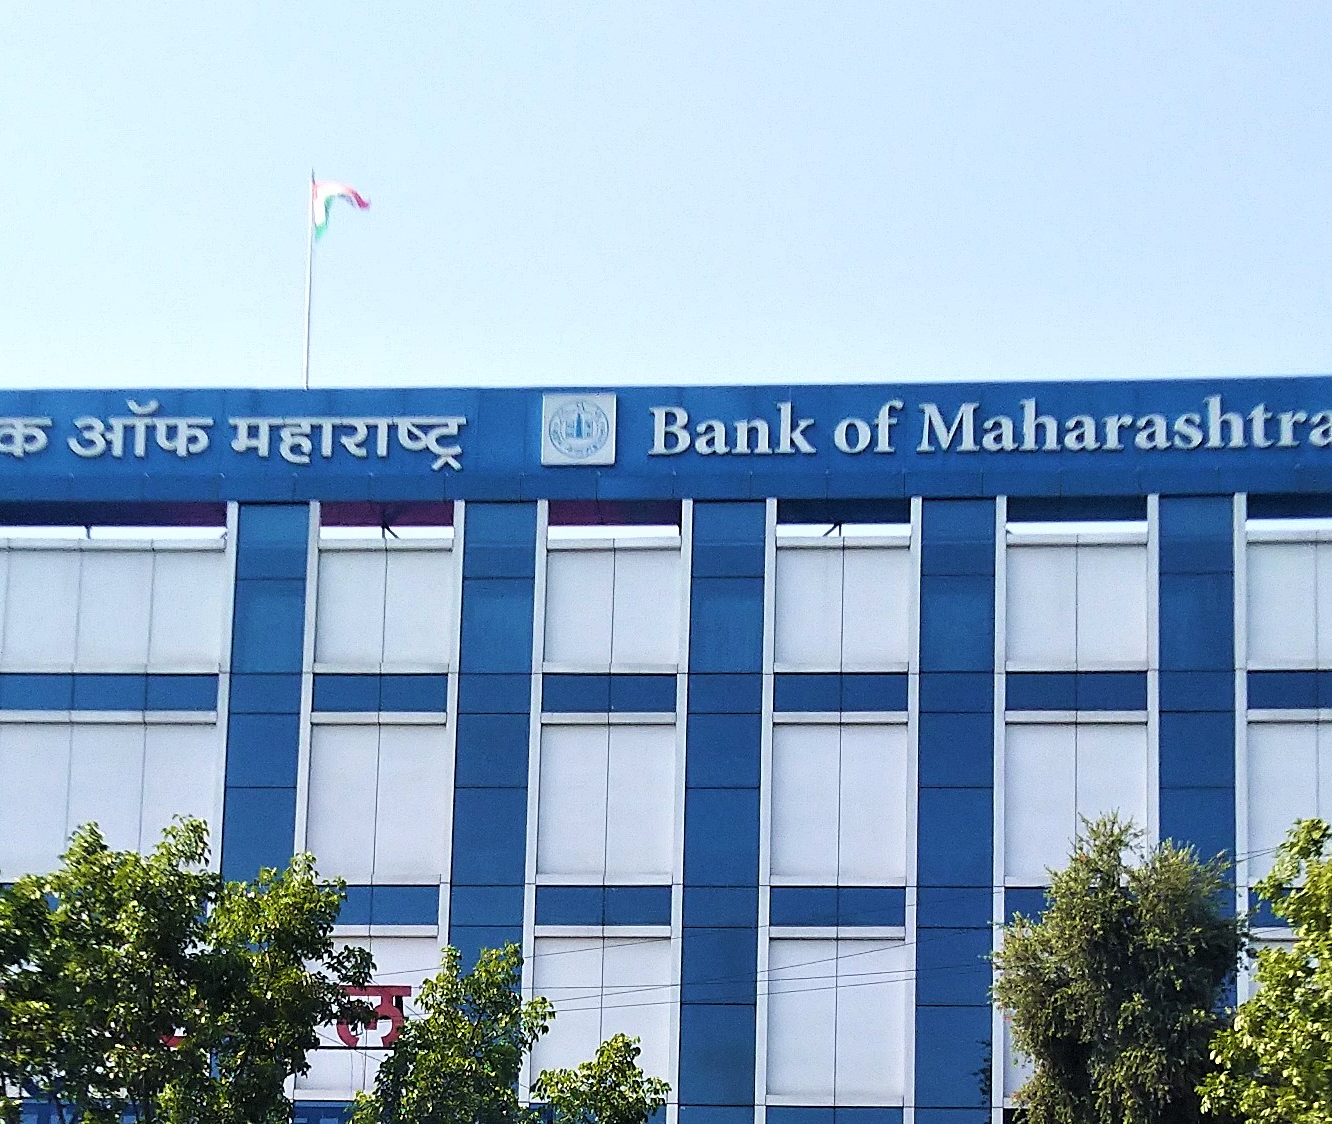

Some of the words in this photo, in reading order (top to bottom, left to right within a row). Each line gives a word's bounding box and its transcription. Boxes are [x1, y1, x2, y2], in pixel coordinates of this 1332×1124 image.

[68, 399, 214, 459] ऑफ
[228, 415, 466, 471] महाराष्ट्र
[647, 402, 816, 458] Bank
[833, 399, 904, 455] of
